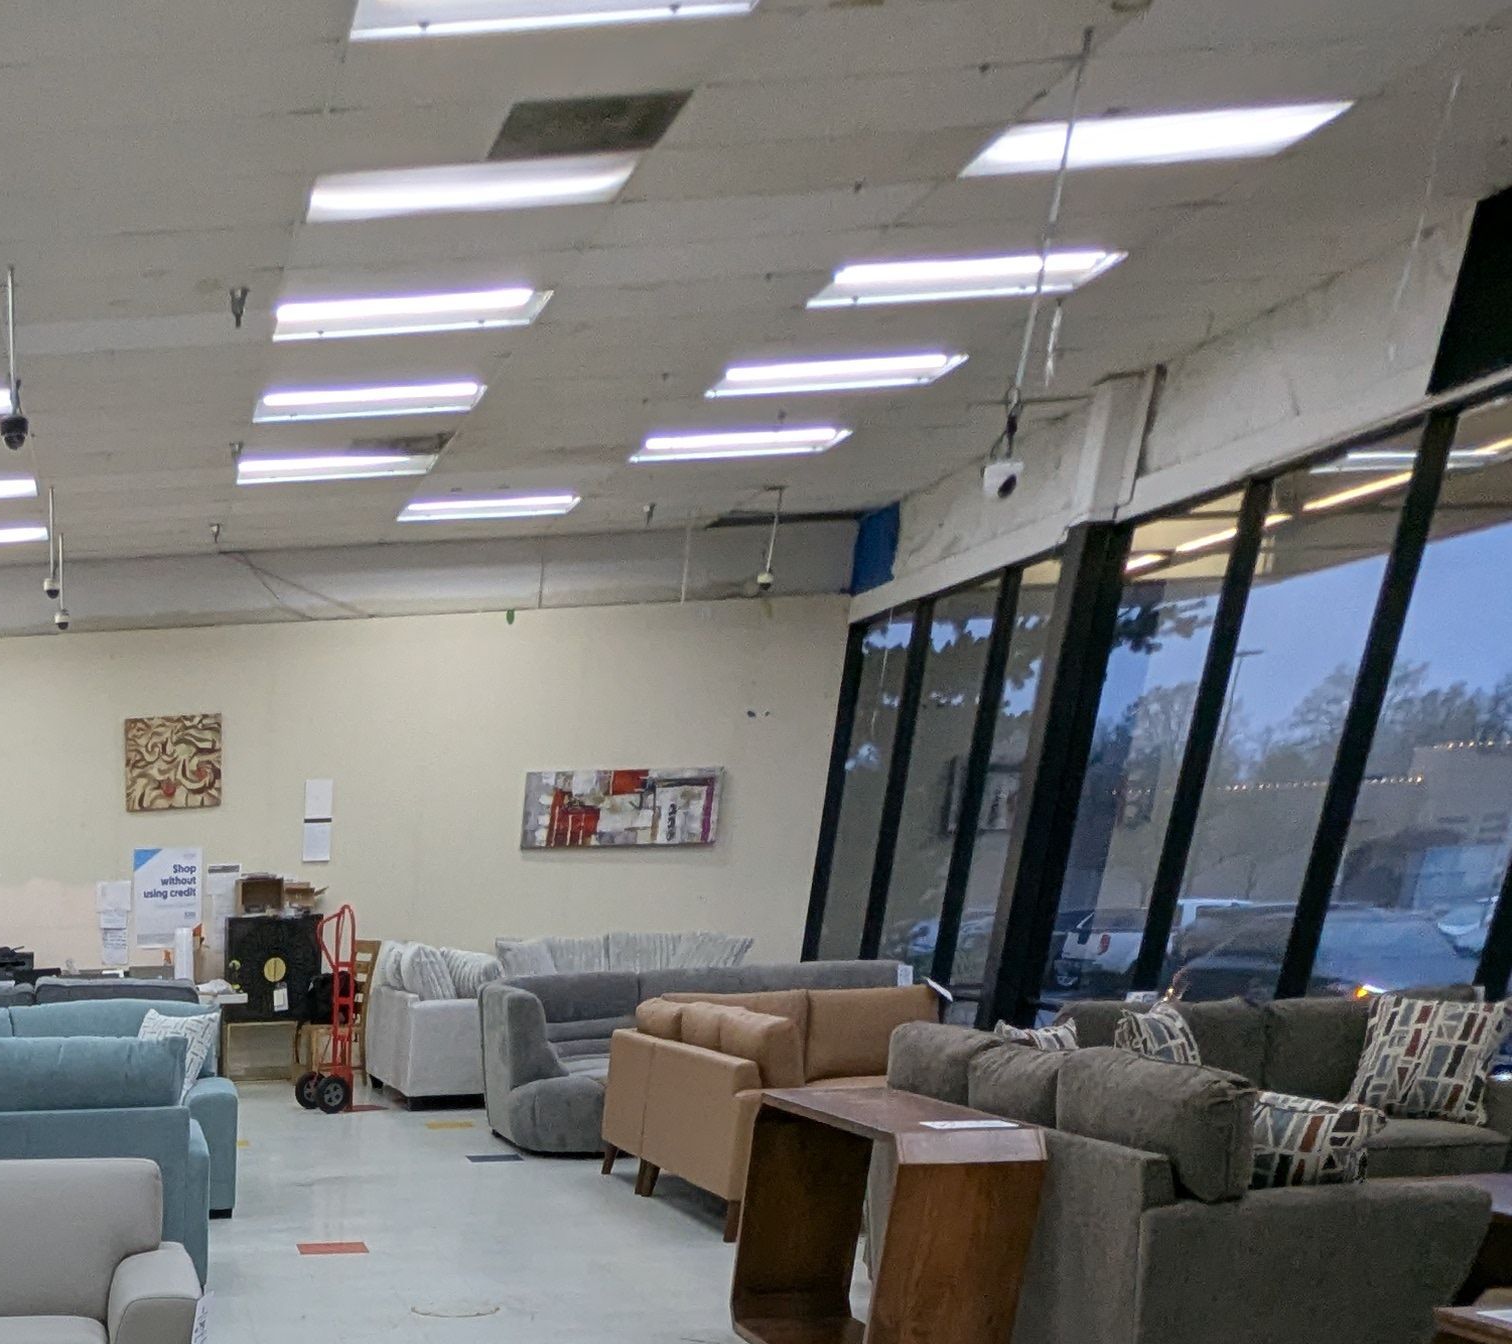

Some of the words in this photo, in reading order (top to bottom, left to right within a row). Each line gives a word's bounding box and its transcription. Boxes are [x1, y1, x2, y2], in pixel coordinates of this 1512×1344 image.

[173, 864, 197, 874] Shop
[161, 876, 196, 886] without
[143, 889, 168, 900] using
[169, 887, 196, 898] credit
